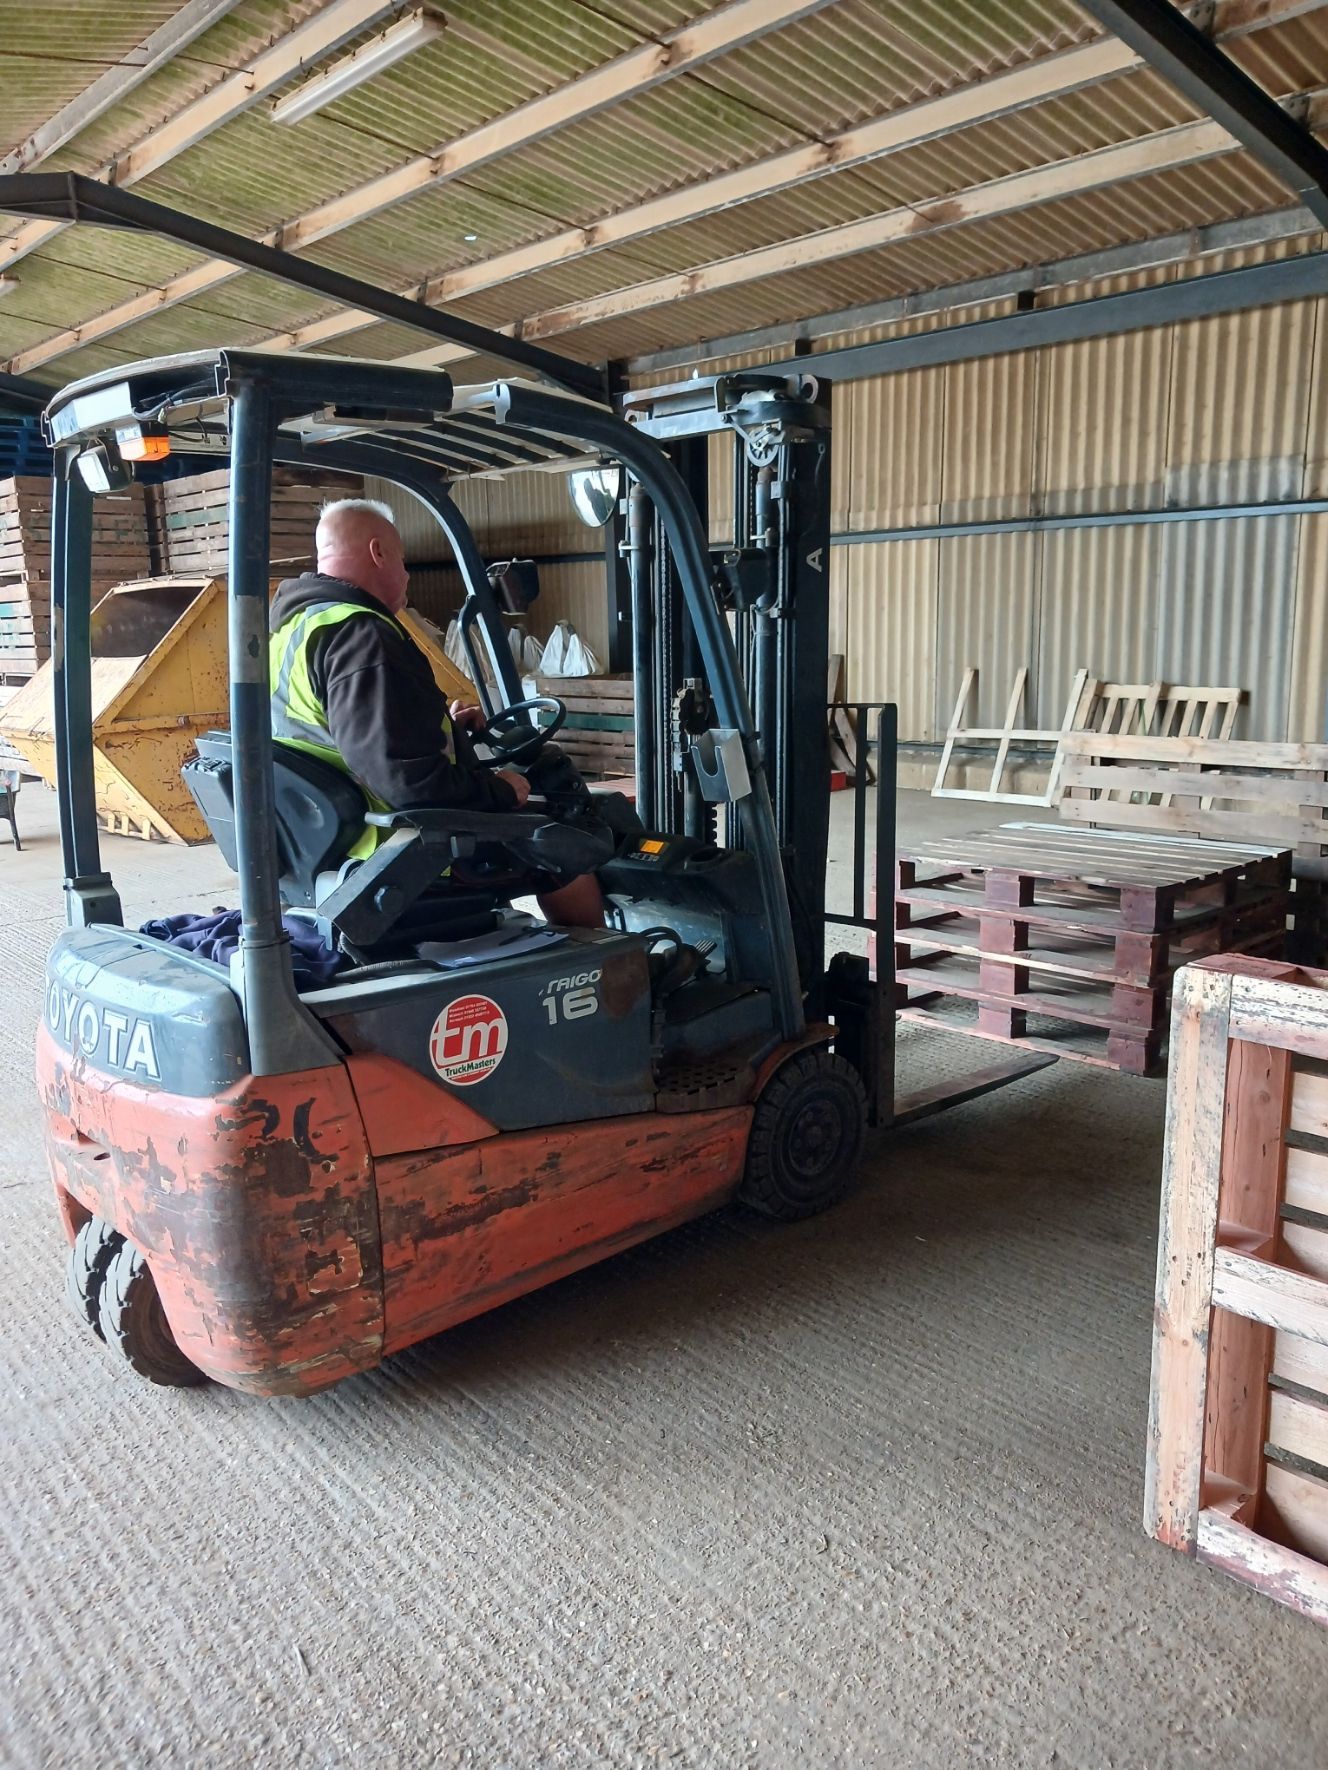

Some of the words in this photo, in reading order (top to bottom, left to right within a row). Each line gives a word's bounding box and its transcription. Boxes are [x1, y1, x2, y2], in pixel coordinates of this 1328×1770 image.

[45, 980, 161, 1081] OYOTA
[542, 986, 599, 1026] 16
[433, 1003, 506, 1067] tm
[444, 1057, 497, 1078] TruckMasters
